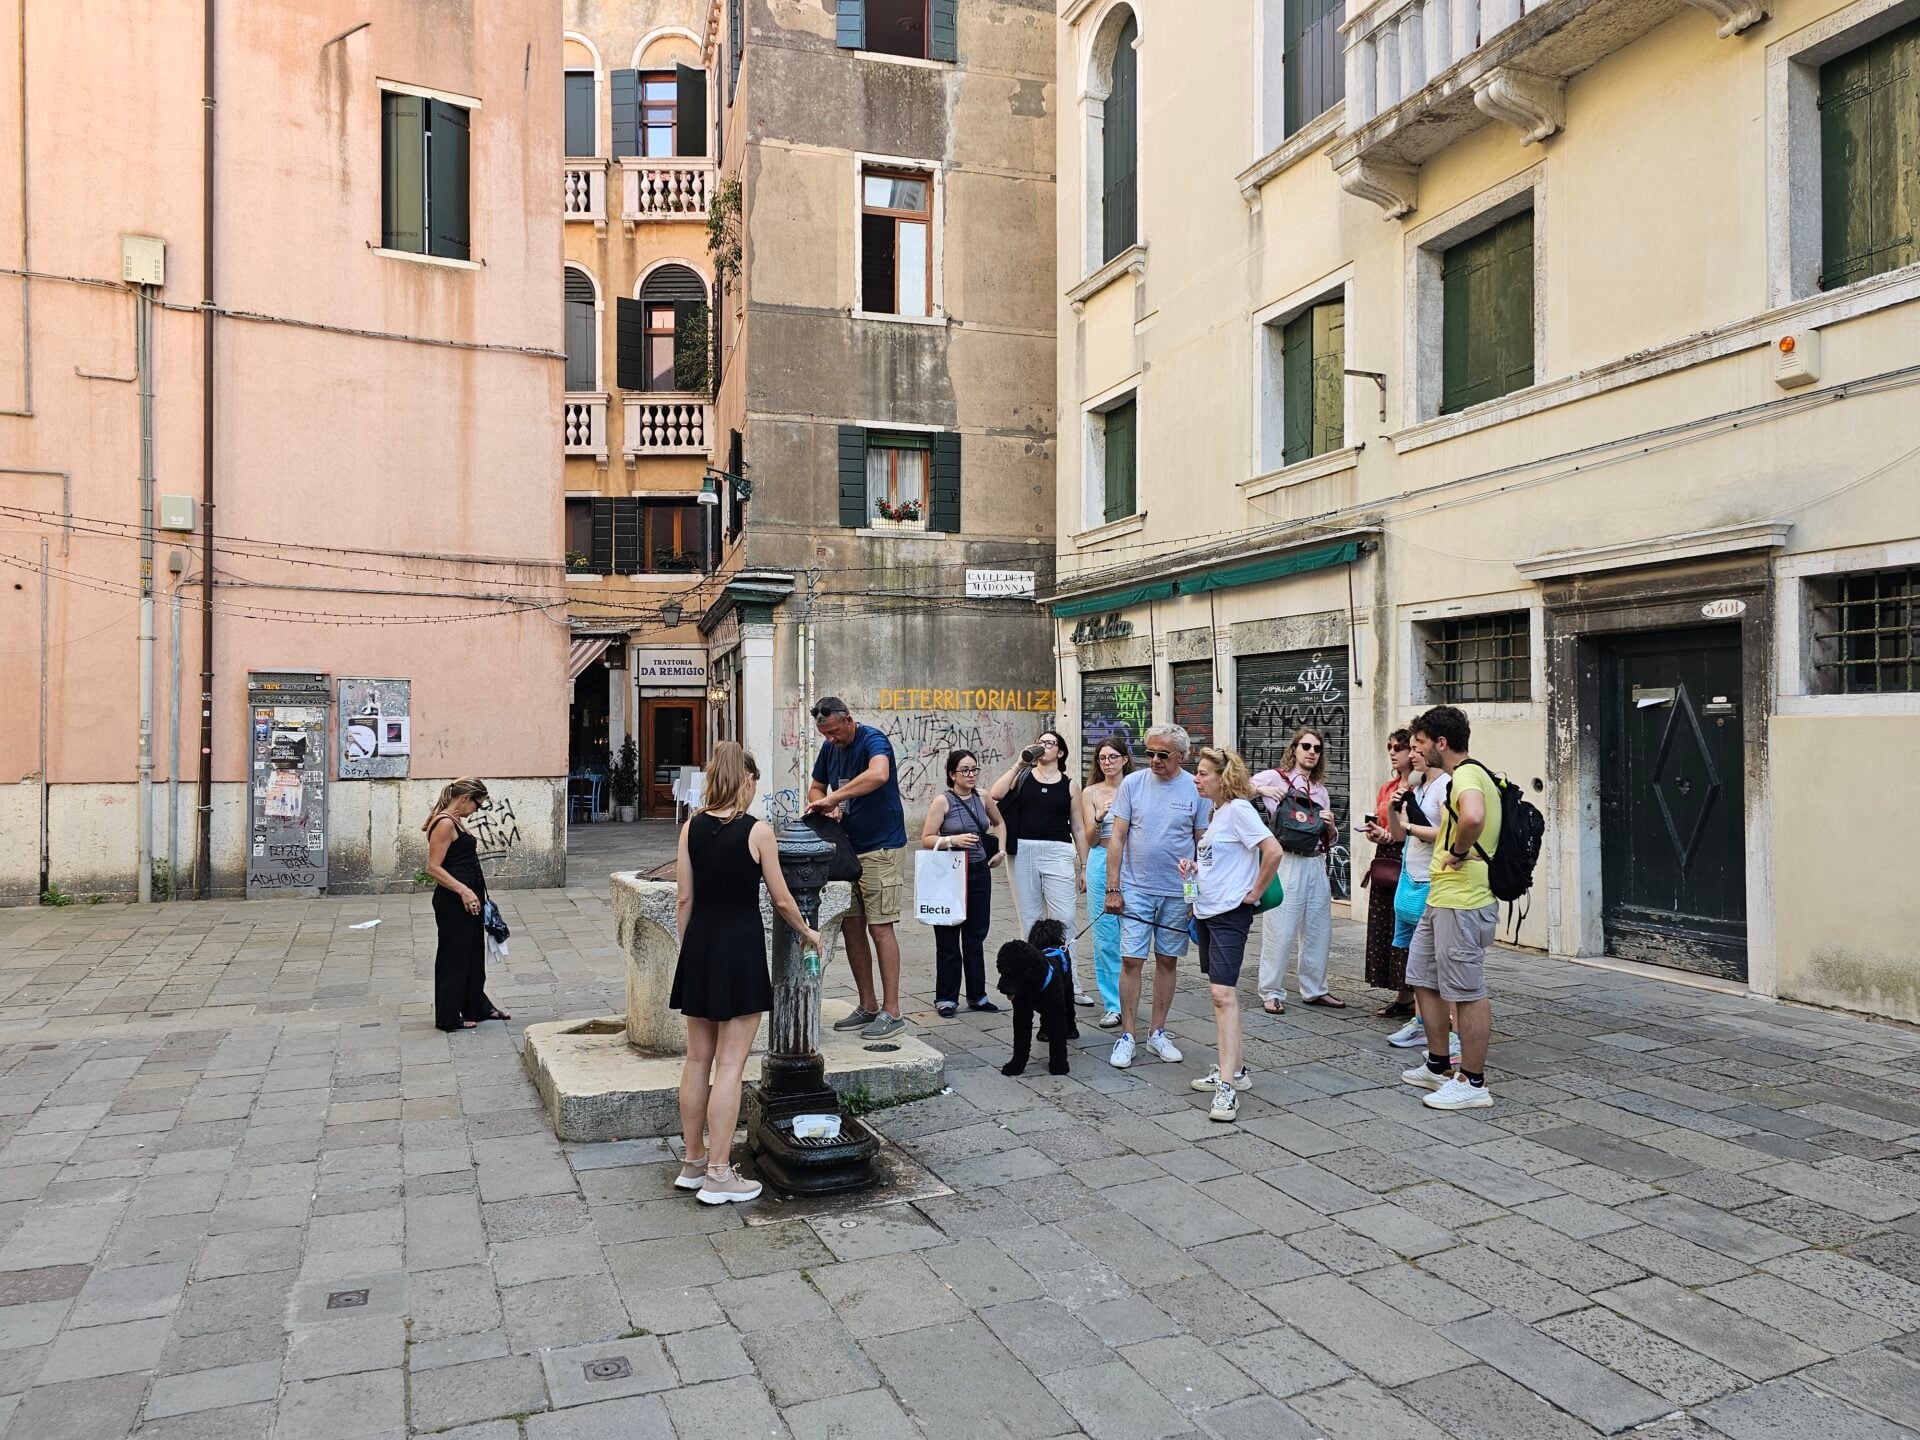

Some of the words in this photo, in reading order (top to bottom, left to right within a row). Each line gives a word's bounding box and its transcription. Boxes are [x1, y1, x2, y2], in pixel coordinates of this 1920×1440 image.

[967, 573, 1003, 582] CALLE
[973, 583, 1025, 591] MADONNA
[1706, 601, 1739, 614] 5401
[641, 667, 656, 676] DA
[659, 667, 705, 676] REMIGIO
[308, 833, 323, 841] BNE
[920, 905, 950, 915] Electa
